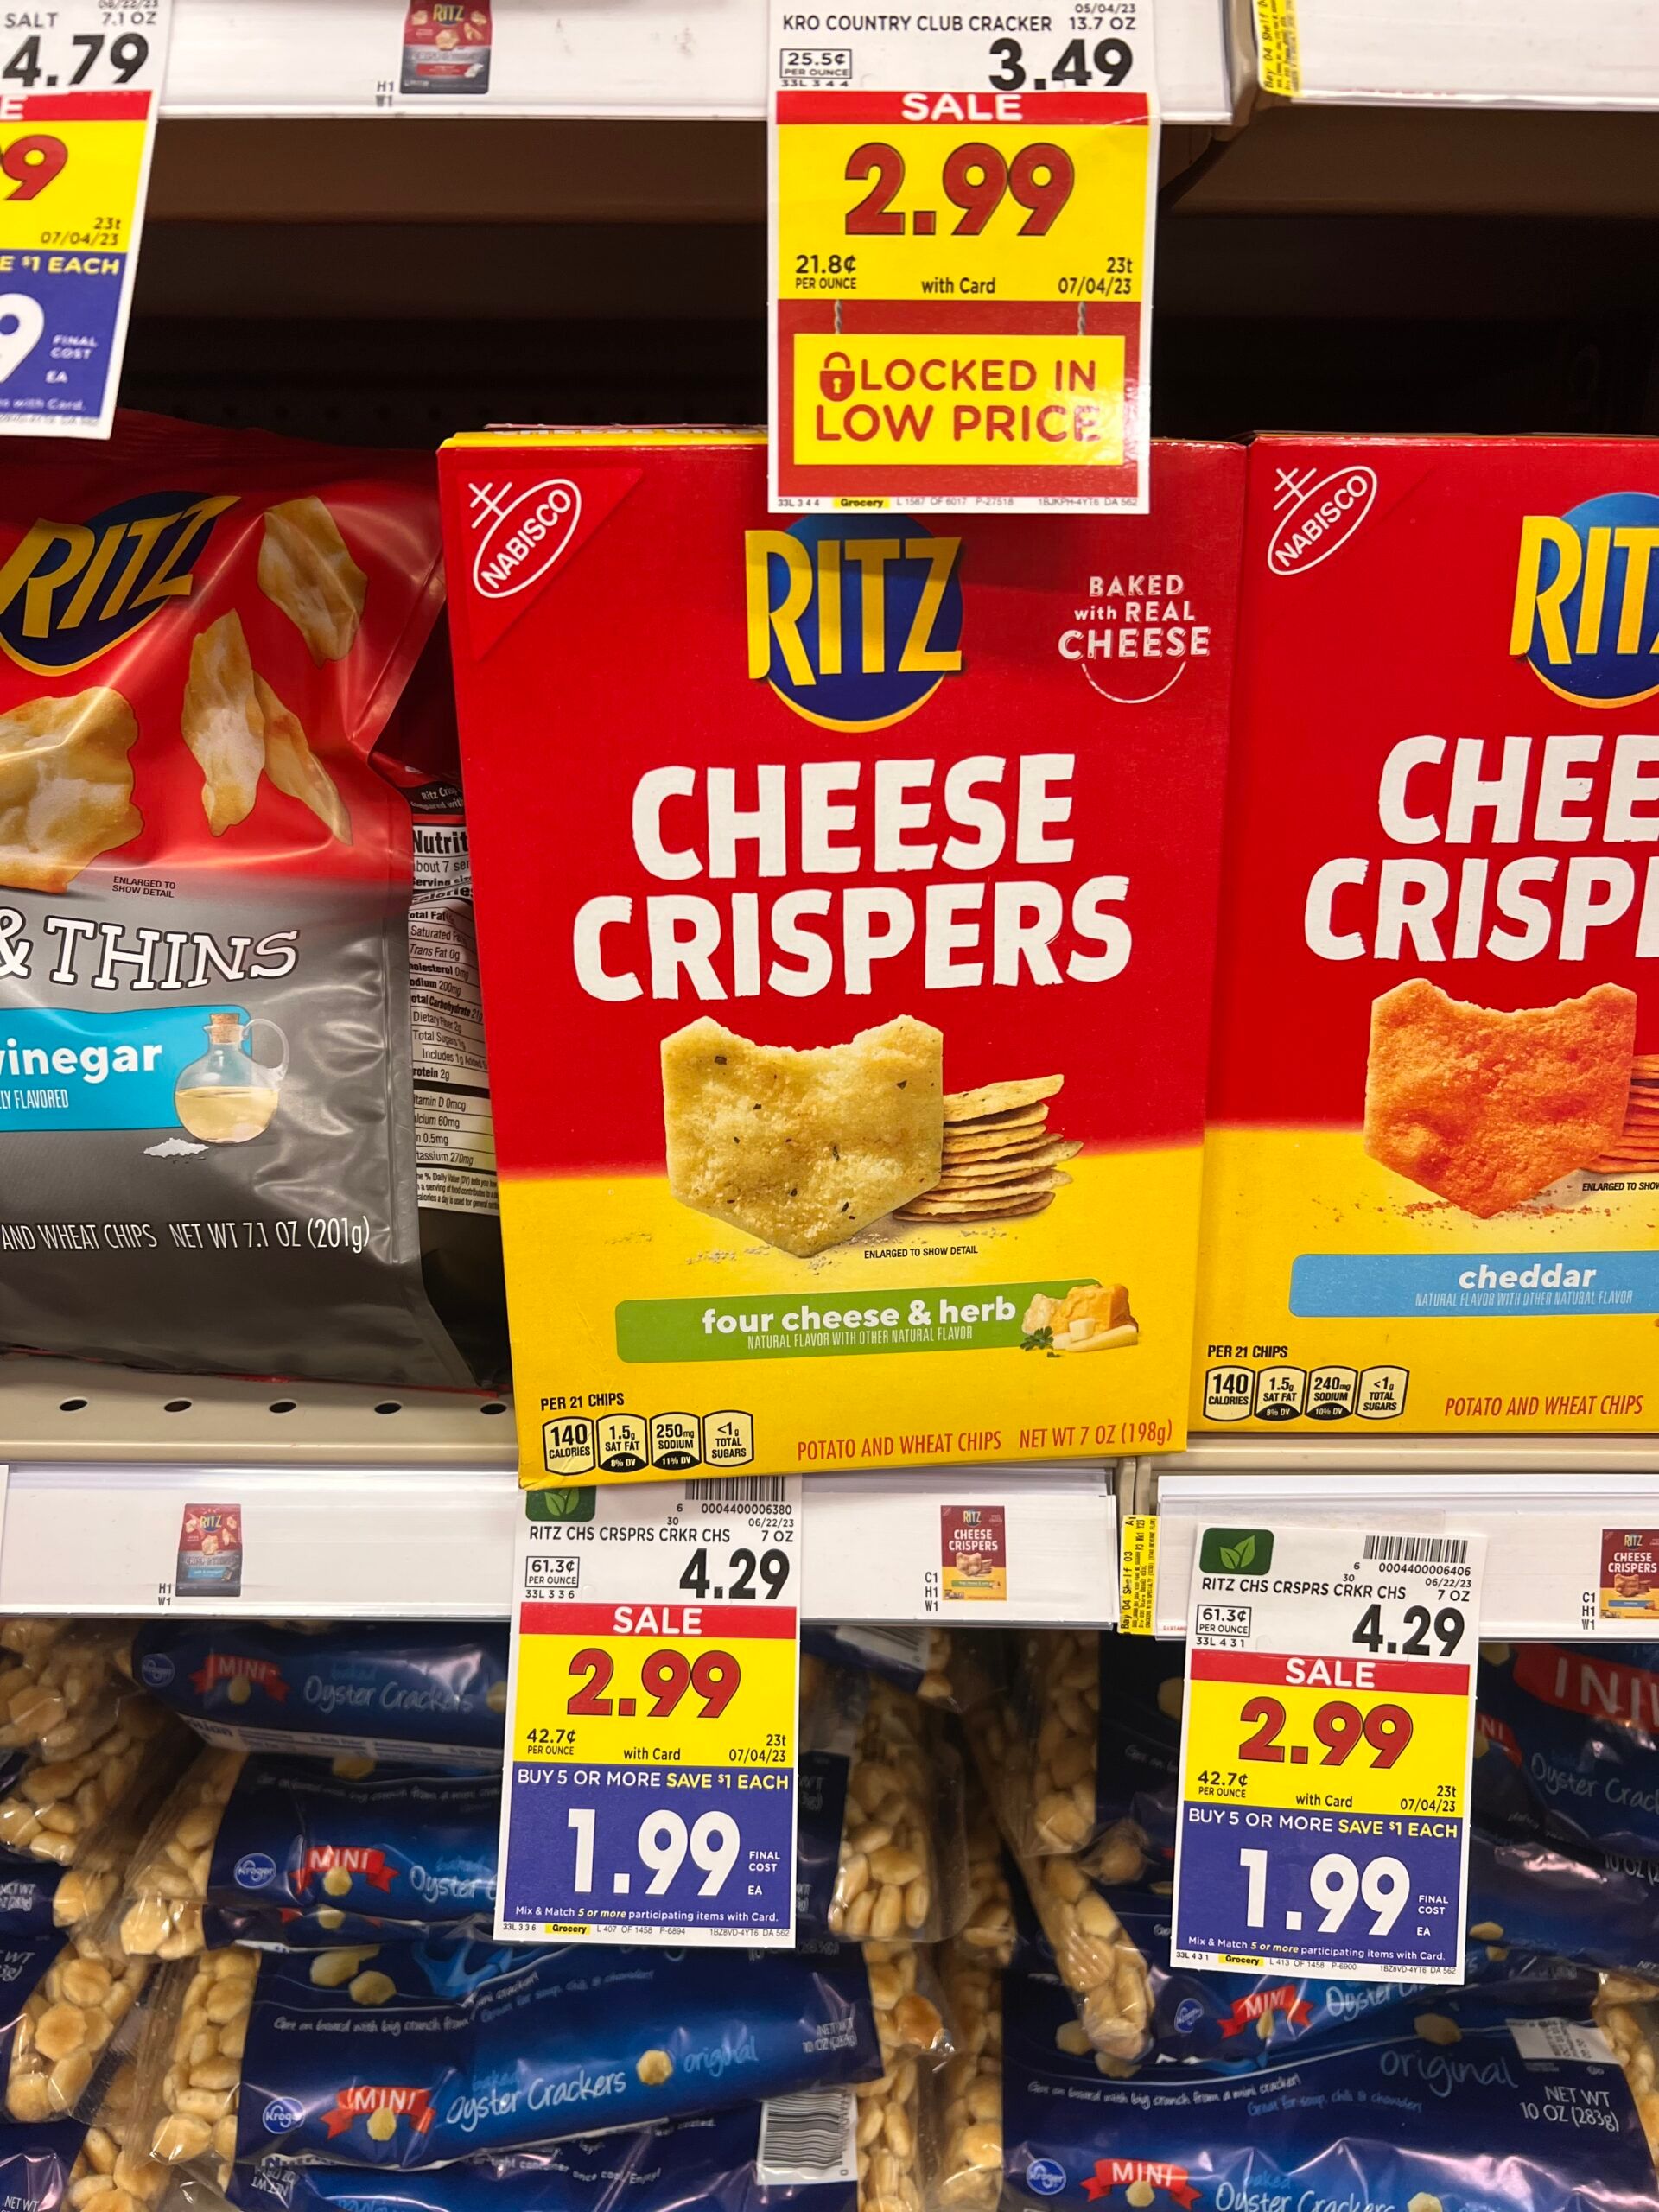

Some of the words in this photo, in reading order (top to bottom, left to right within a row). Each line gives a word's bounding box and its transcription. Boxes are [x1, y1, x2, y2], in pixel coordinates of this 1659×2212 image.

[103, 12, 124, 25] 7.1
[131, 11, 156, 24] OZ
[434, 3, 464, 22] RITZ
[1075, 3, 1136, 15] 05/04/23
[4, 12, 57, 28] SALT
[783, 16, 820, 31] KRO
[825, 16, 910, 32] COUNTRY
[917, 16, 963, 32] CLUB
[969, 16, 1052, 32] CRACKER
[1070, 17, 1103, 30] 13.7
[1110, 17, 1136, 30] OZ
[3, 33, 149, 86] 4.79
[787, 52, 846, 67] 25.5¢
[988, 37, 1134, 92] 3.49
[901, 93, 1023, 121] SALE
[844, 142, 1075, 236] 2.99
[41, 232, 118, 245] 07/04/23
[22, 256, 40, 271] $1
[48, 257, 119, 275] EACH
[921, 277, 956, 294] with
[959, 277, 996, 294] Card
[1058, 277, 1132, 295] 07/04/23
[861, 359, 1037, 391] LOCKED
[1055, 359, 1096, 391] IN
[816, 404, 934, 442] LOW
[952, 404, 1100, 442] PRICE
[840, 499, 884, 508] Grocery
[931, 498, 943, 506] OF
[945, 498, 967, 506] 6017
[976, 498, 1014, 506] P-27518
[1274, 474, 1370, 567] NABISCO
[480, 488, 572, 589] NABISCO
[0, 495, 242, 639] RITZ
[1089, 574, 1185, 598] BAKED
[1509, 514, 1659, 664] RIT
[745, 530, 962, 686] RITZ
[1074, 605, 1117, 620] with
[1125, 601, 1196, 623] REAL
[1058, 626, 1211, 660] CHEESE
[631, 754, 1075, 880] CHEESE
[411, 925, 451, 941] Saturated
[574, 876, 1132, 1001] CRISPERS
[42, 913, 302, 991] THINS
[410, 944, 433, 957] Trans
[435, 949, 448, 958] Fat
[0, 1039, 162, 1084] inegar
[438, 1116, 460, 1129] 60mg
[450, 1153, 474, 1166] 270mg
[3, 1225, 35, 1250] AND
[38, 1224, 97, 1250] WHEAT
[105, 1224, 157, 1249] CHIPS
[170, 1223, 203, 1249] NET
[208, 1222, 236, 1249] WT
[244, 1222, 269, 1248] 7.1
[277, 1221, 302, 1246] OZ
[307, 1216, 369, 1253] (201g)
[864, 1248, 907, 1261] ENLARGED
[910, 1248, 920, 1258] TO
[922, 1246, 948, 1257] SHOW
[950, 1244, 978, 1255] DETAIL
[1459, 1263, 1596, 1290] cheddar
[702, 1307, 775, 1333] four
[781, 1300, 906, 1331] cheese
[909, 1300, 931, 1325] &
[939, 1295, 1016, 1324] herb
[541, 1397, 566, 1411] PER
[569, 1396, 583, 1408] 21
[588, 1393, 625, 1408] CHIPS
[550, 1423, 588, 1446] 140
[715, 1437, 742, 1447] TOTAL
[798, 1438, 856, 1461] POTATO
[861, 1436, 894, 1458] AND
[899, 1433, 951, 1456] WHEAT
[957, 1430, 1001, 1452] CHIPS
[1020, 1429, 1047, 1449] NET
[1052, 1427, 1075, 1446] WT
[1079, 1427, 1089, 1446] 7
[1095, 1424, 1116, 1445] OZ
[1121, 1419, 1173, 1446] (198g)
[549, 1446, 591, 1459] CALORIES
[658, 1440, 693, 1450] SODIUM
[711, 1447, 747, 1459] SUGARS
[702, 1503, 792, 1515] 0004400006380
[530, 1526, 561, 1540] RITZ
[567, 1527, 594, 1541] CHS
[599, 1527, 654, 1541] CRSPRS
[659, 1529, 696, 1542] CRKR
[702, 1529, 730, 1542] CHS
[761, 1530, 768, 1541] 7
[773, 1530, 793, 1542] OZ
[1123, 1551, 1133, 1561] 03
[1614, 1552, 1652, 1562] CHEESE
[532, 1560, 575, 1573] 61.3¢
[679, 1548, 790, 1599] 4.29
[1379, 1563, 1471, 1576] 0004400006406
[1608, 1563, 1657, 1573] CRISPERS
[1426, 1578, 1471, 1588] 06/22/23
[1122, 1600, 1131, 1610] 04
[613, 1606, 702, 1635] SALE
[1121, 1615, 1133, 1630] Bay
[1352, 1604, 1465, 1656] 4.29
[218, 1656, 266, 1680] MINI
[1286, 1658, 1376, 1688] SALE
[567, 1648, 741, 1718] 2.99
[303, 1675, 375, 1714] Oyster
[526, 1728, 576, 1744] 42.7¢
[1239, 1696, 1413, 1769] 2.99
[728, 1749, 786, 1763] 07/04/23
[518, 1769, 554, 1784] BUY
[557, 1770, 567, 1784] 5
[574, 1770, 601, 1785] OR
[607, 1772, 660, 1786] MORE
[666, 1773, 712, 1789] SAVE
[718, 1775, 731, 1789] $1
[737, 1775, 789, 1789] EACH
[309, 1849, 369, 1870] MINI
[568, 1808, 741, 1897] 1.99
[1240, 1848, 1410, 1936] 1.99
[516, 1906, 532, 1915] Mix
[545, 1908, 575, 1916] Match
[578, 1909, 584, 1917] 5
[629, 1910, 694, 1922] participating
[696, 1911, 724, 1921] items
[727, 1912, 748, 1921] with
[752, 1912, 779, 1922] Card.
[446, 2088, 518, 2133] Oyster
[526, 2071, 626, 2111] Crackers
[1545, 2086, 1579, 2105] NET
[1583, 2088, 1610, 2107] WT
[1520, 2102, 1540, 2119] 10
[1543, 2103, 1569, 2124] OZ
[1571, 2104, 1620, 2132] (283g)
